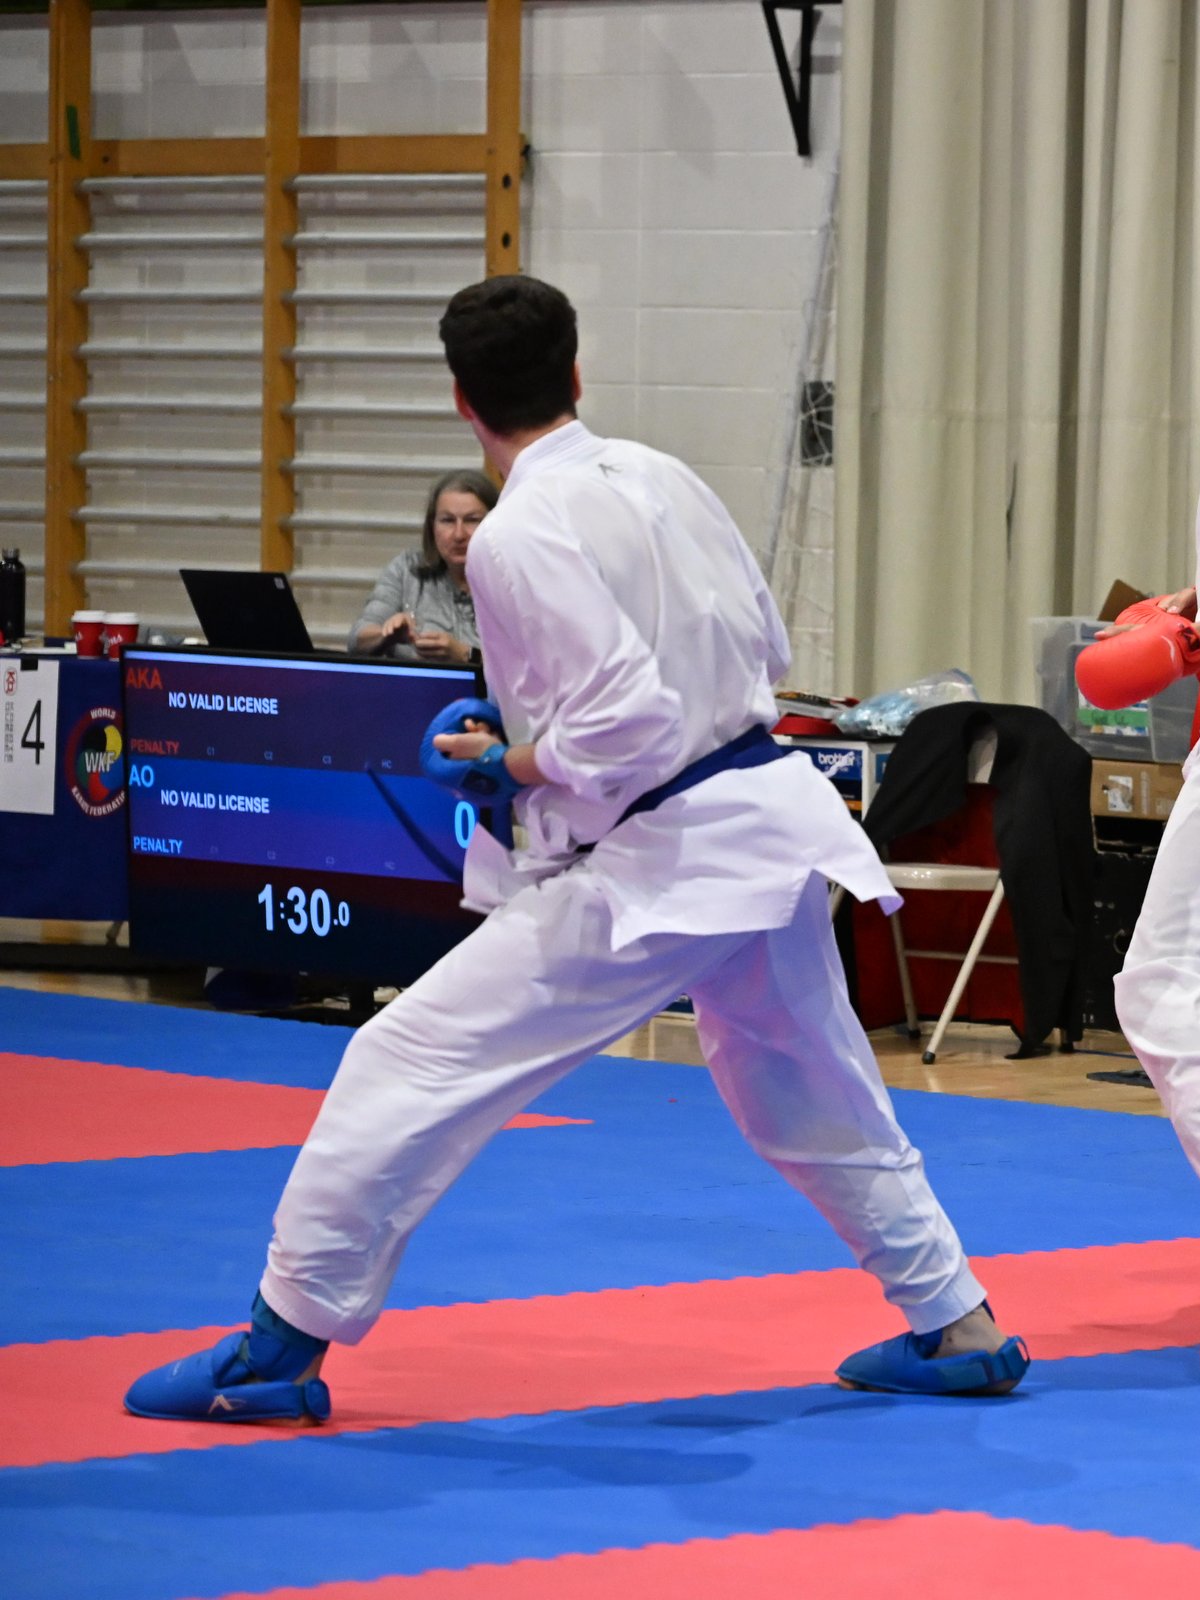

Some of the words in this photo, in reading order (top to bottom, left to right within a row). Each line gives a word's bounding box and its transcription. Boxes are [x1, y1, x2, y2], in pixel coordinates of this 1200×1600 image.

[126, 667, 163, 689] AKA
[90, 706, 117, 719] WORLD
[168, 691, 187, 709] NO
[189, 693, 224, 711] VALID
[227, 696, 279, 715] LICENSE
[21, 698, 45, 765] 4
[130, 738, 180, 755] PENALTY
[84, 751, 116, 773] WKF
[129, 764, 155, 788] AO
[89, 790, 126, 817] FEDERATI
[160, 789, 179, 806] NO
[180, 791, 216, 809] VALID
[219, 795, 270, 814] LICENSE
[454, 800, 476, 849] 0
[133, 836, 183, 854] PENALTY
[258, 884, 350, 937] 1:30.0
